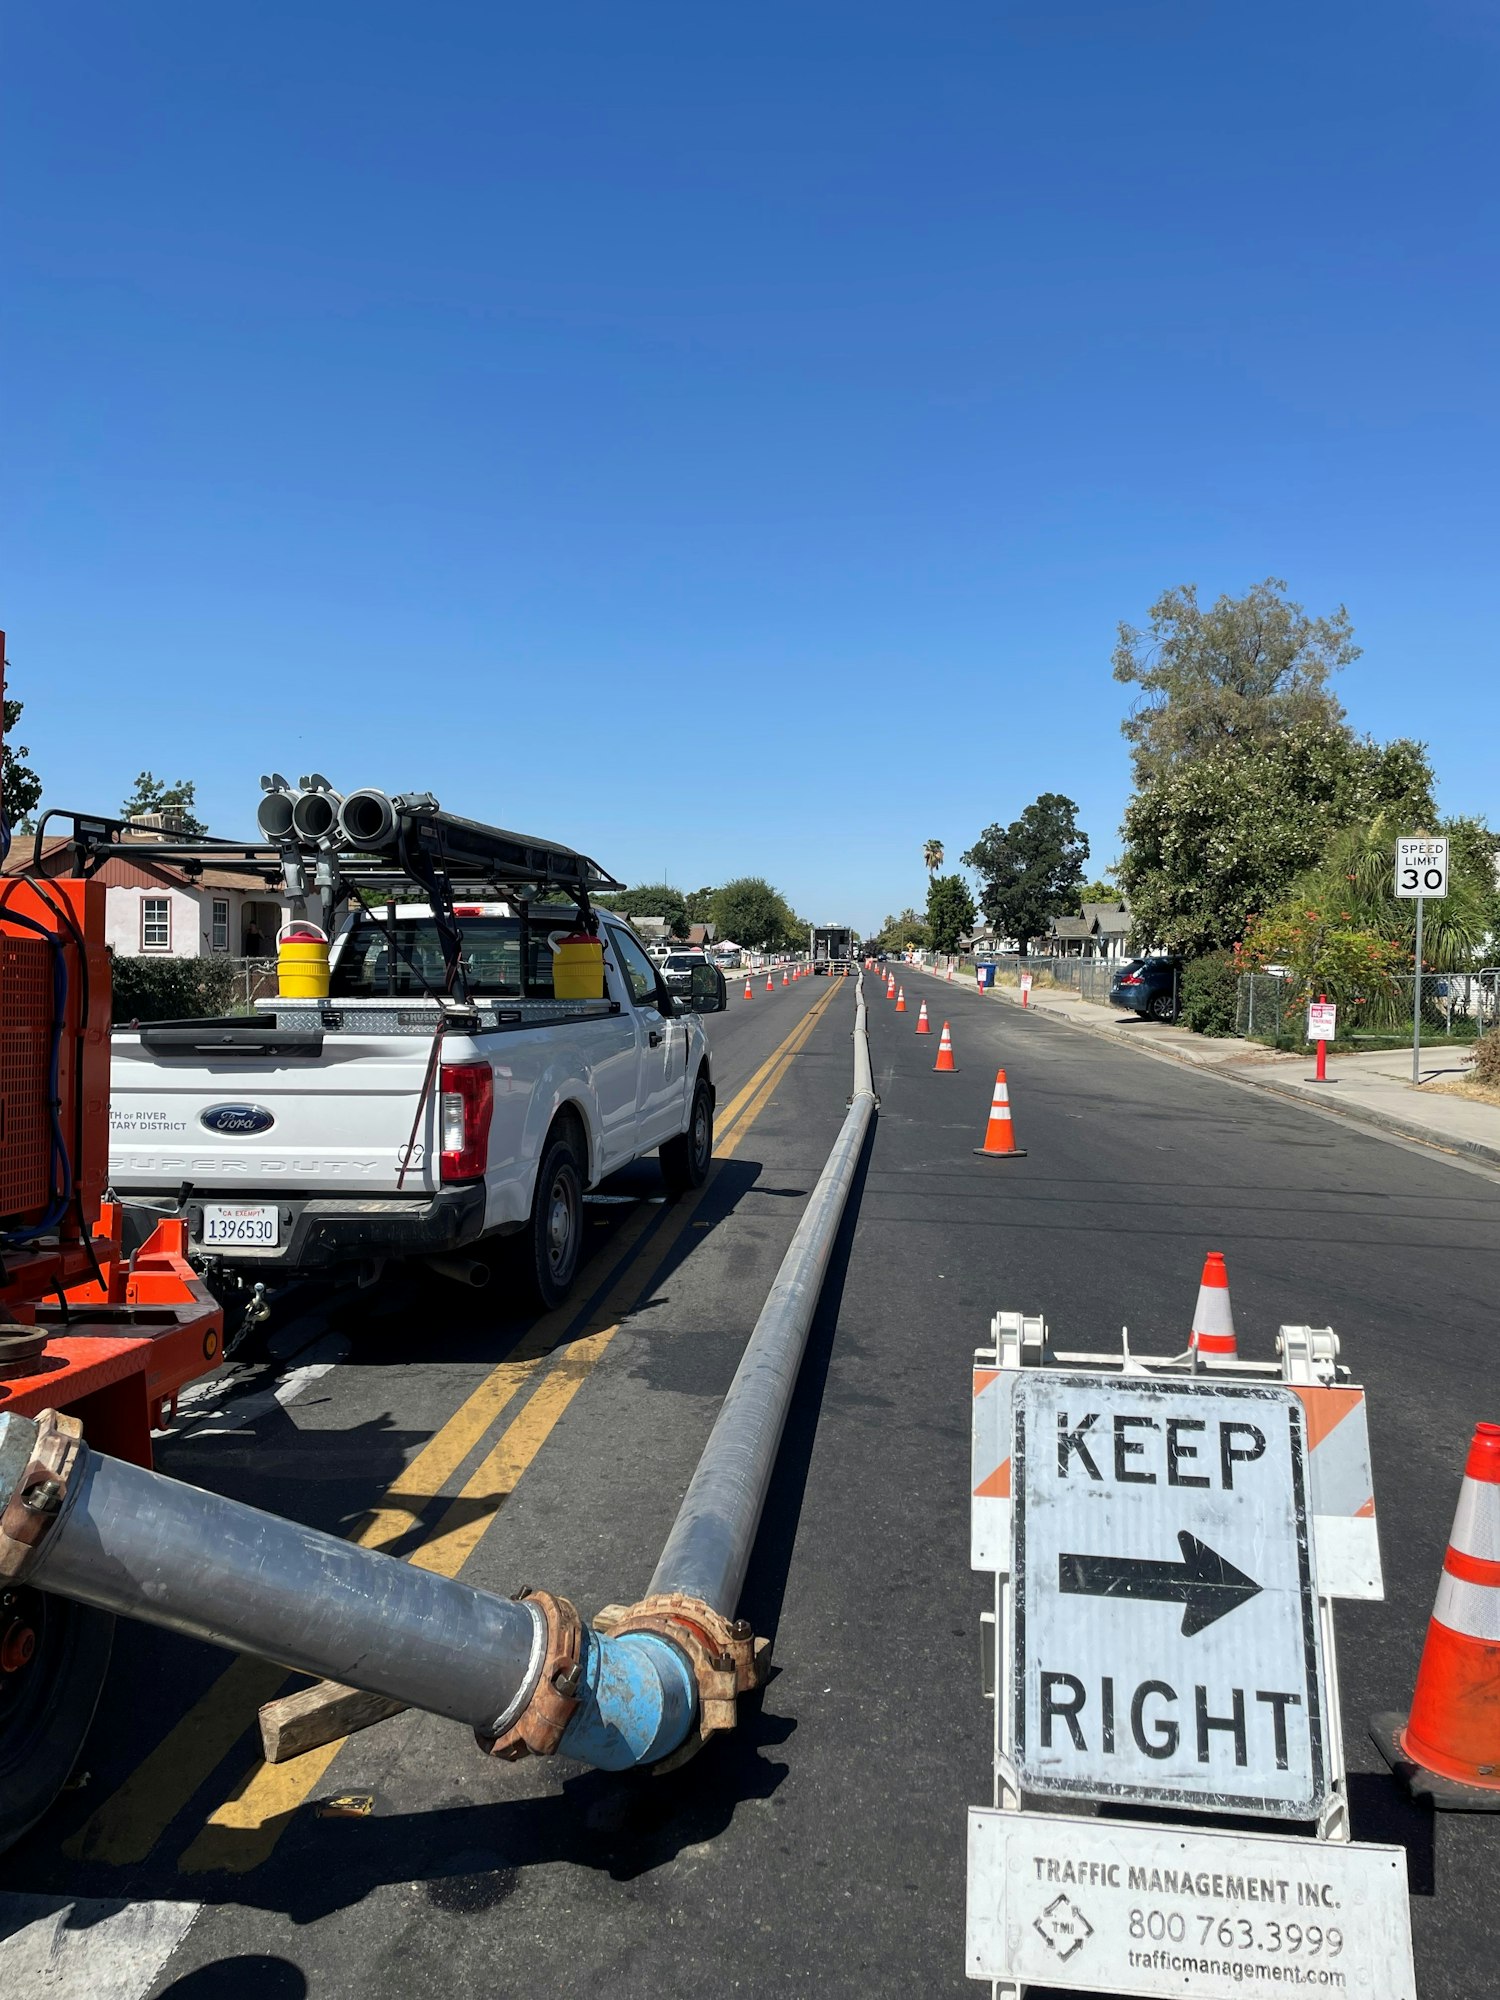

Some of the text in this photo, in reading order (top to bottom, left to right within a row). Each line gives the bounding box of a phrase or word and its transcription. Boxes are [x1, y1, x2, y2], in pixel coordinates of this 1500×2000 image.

[1401, 844, 1443, 854] SPEED
[1405, 856, 1438, 866] LIMIT
[1401, 868, 1443, 890] 30
[409, 1013, 442, 1021] HUSKY
[136, 1111, 167, 1120] RIVER
[216, 1110, 258, 1129] Ford
[140, 1122, 187, 1131] DISTRICT
[260, 1159, 379, 1174] DUTY
[208, 1219, 273, 1239] 1396530
[1056, 1411, 1267, 1490] KEEP
[1039, 1671, 1301, 1771] RIGHT
[1033, 1856, 1342, 1909] TRAFFIC MANAGEMENT INC.
[1052, 1921, 1075, 1935] TMI
[1128, 1908, 1344, 1958] 800 763.3999
[1128, 1949, 1347, 1988] trafficmanagement.com
